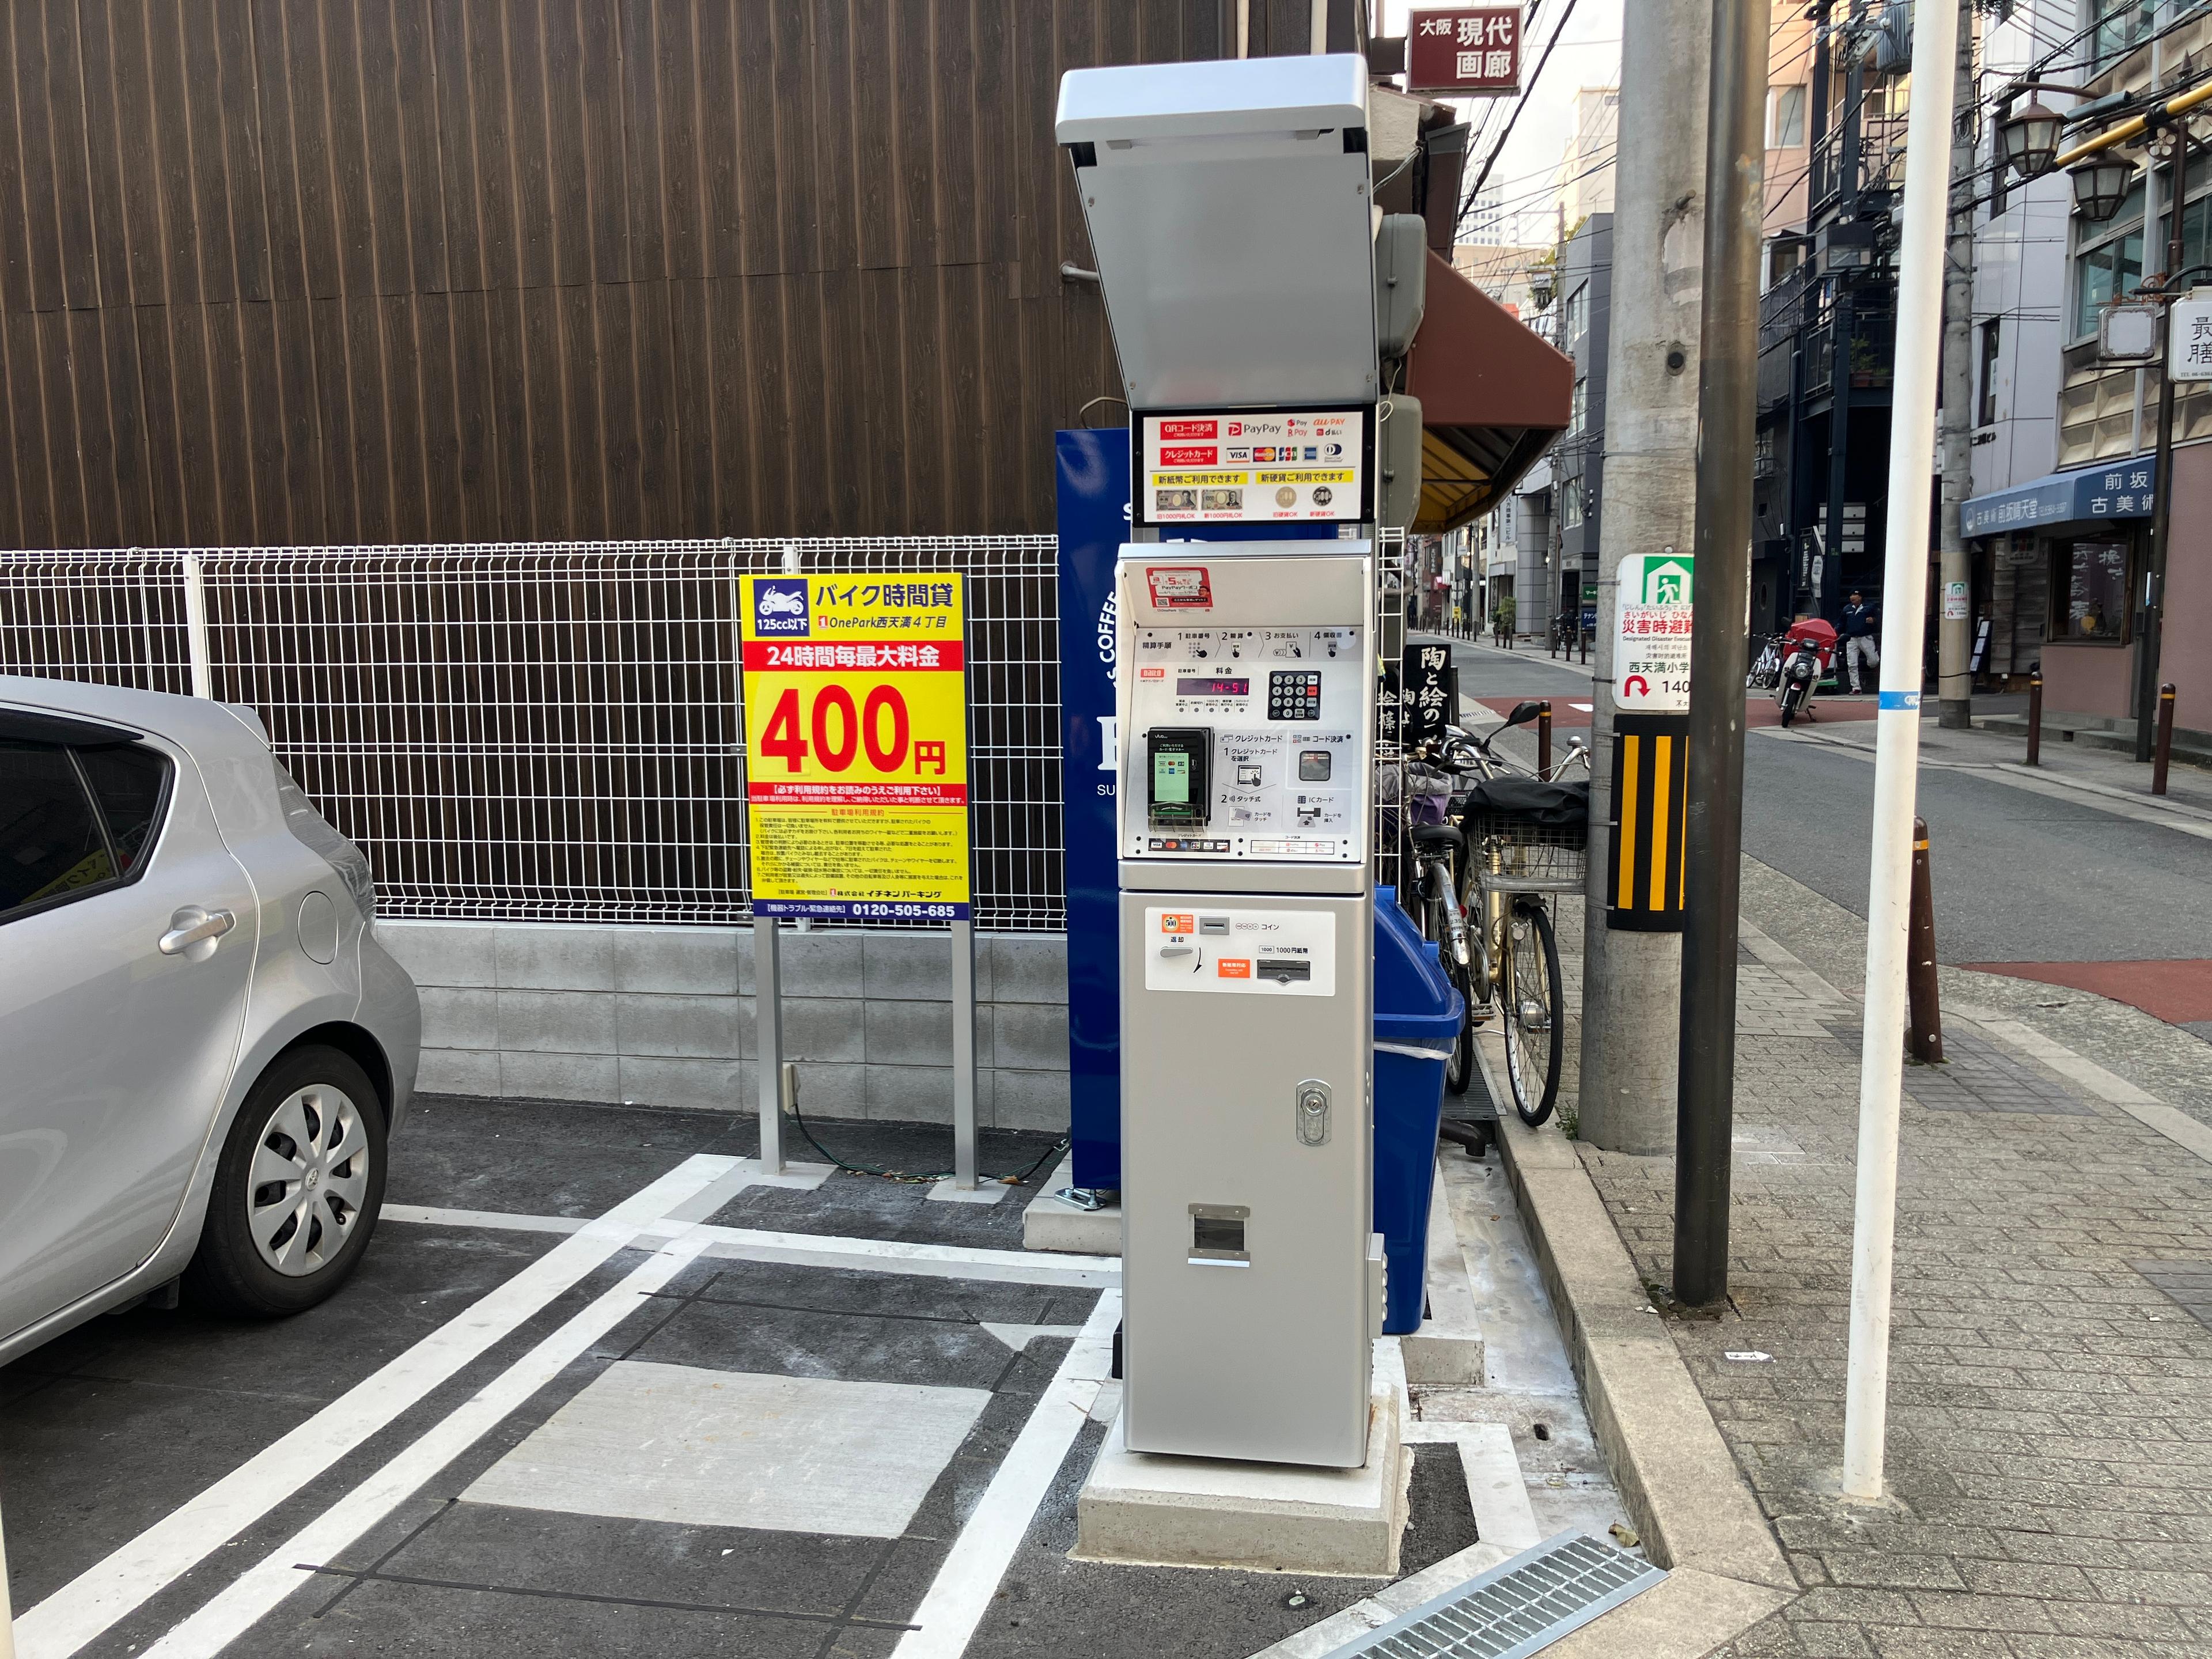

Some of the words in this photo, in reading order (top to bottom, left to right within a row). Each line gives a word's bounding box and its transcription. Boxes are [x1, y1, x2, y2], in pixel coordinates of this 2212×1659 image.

[1419, 17, 1452, 36] 大阪
[1456, 16, 1512, 47] 現代
[1456, 49, 1512, 79] 画廊
[1165, 423, 1213, 433] QRコード決済
[1244, 424, 1281, 435] PayPay
[1165, 450, 1213, 459] クレジットカード
[1158, 474, 1240, 484] 新紙幣ご利用できます
[1261, 472, 1344, 482] 新硬貨ご利用できます
[2105, 471, 2147, 491] 前坂
[2091, 493, 2154, 514] 古美術
[816, 584, 953, 608] バイク時間貸
[757, 619, 808, 631] 125cc以下
[1177, 632, 1182, 640] 1
[1221, 632, 1228, 640] 2
[1265, 632, 1271, 640] 3
[1314, 631, 1321, 639] 4
[767, 646, 940, 667] 24時間毎最大料金
[1628, 662, 1689, 673] 西天満小学
[1662, 680, 1691, 693] 140
[761, 684, 945, 775] 400円
[1235, 734, 1282, 743] クレジットカード
[1312, 735, 1343, 743] コード決済
[1224, 747, 1228, 756] 1
[1221, 794, 1227, 802] 2
[831, 808, 884, 816] 駐車場利用規約
[853, 903, 955, 917] 0120-505-685
